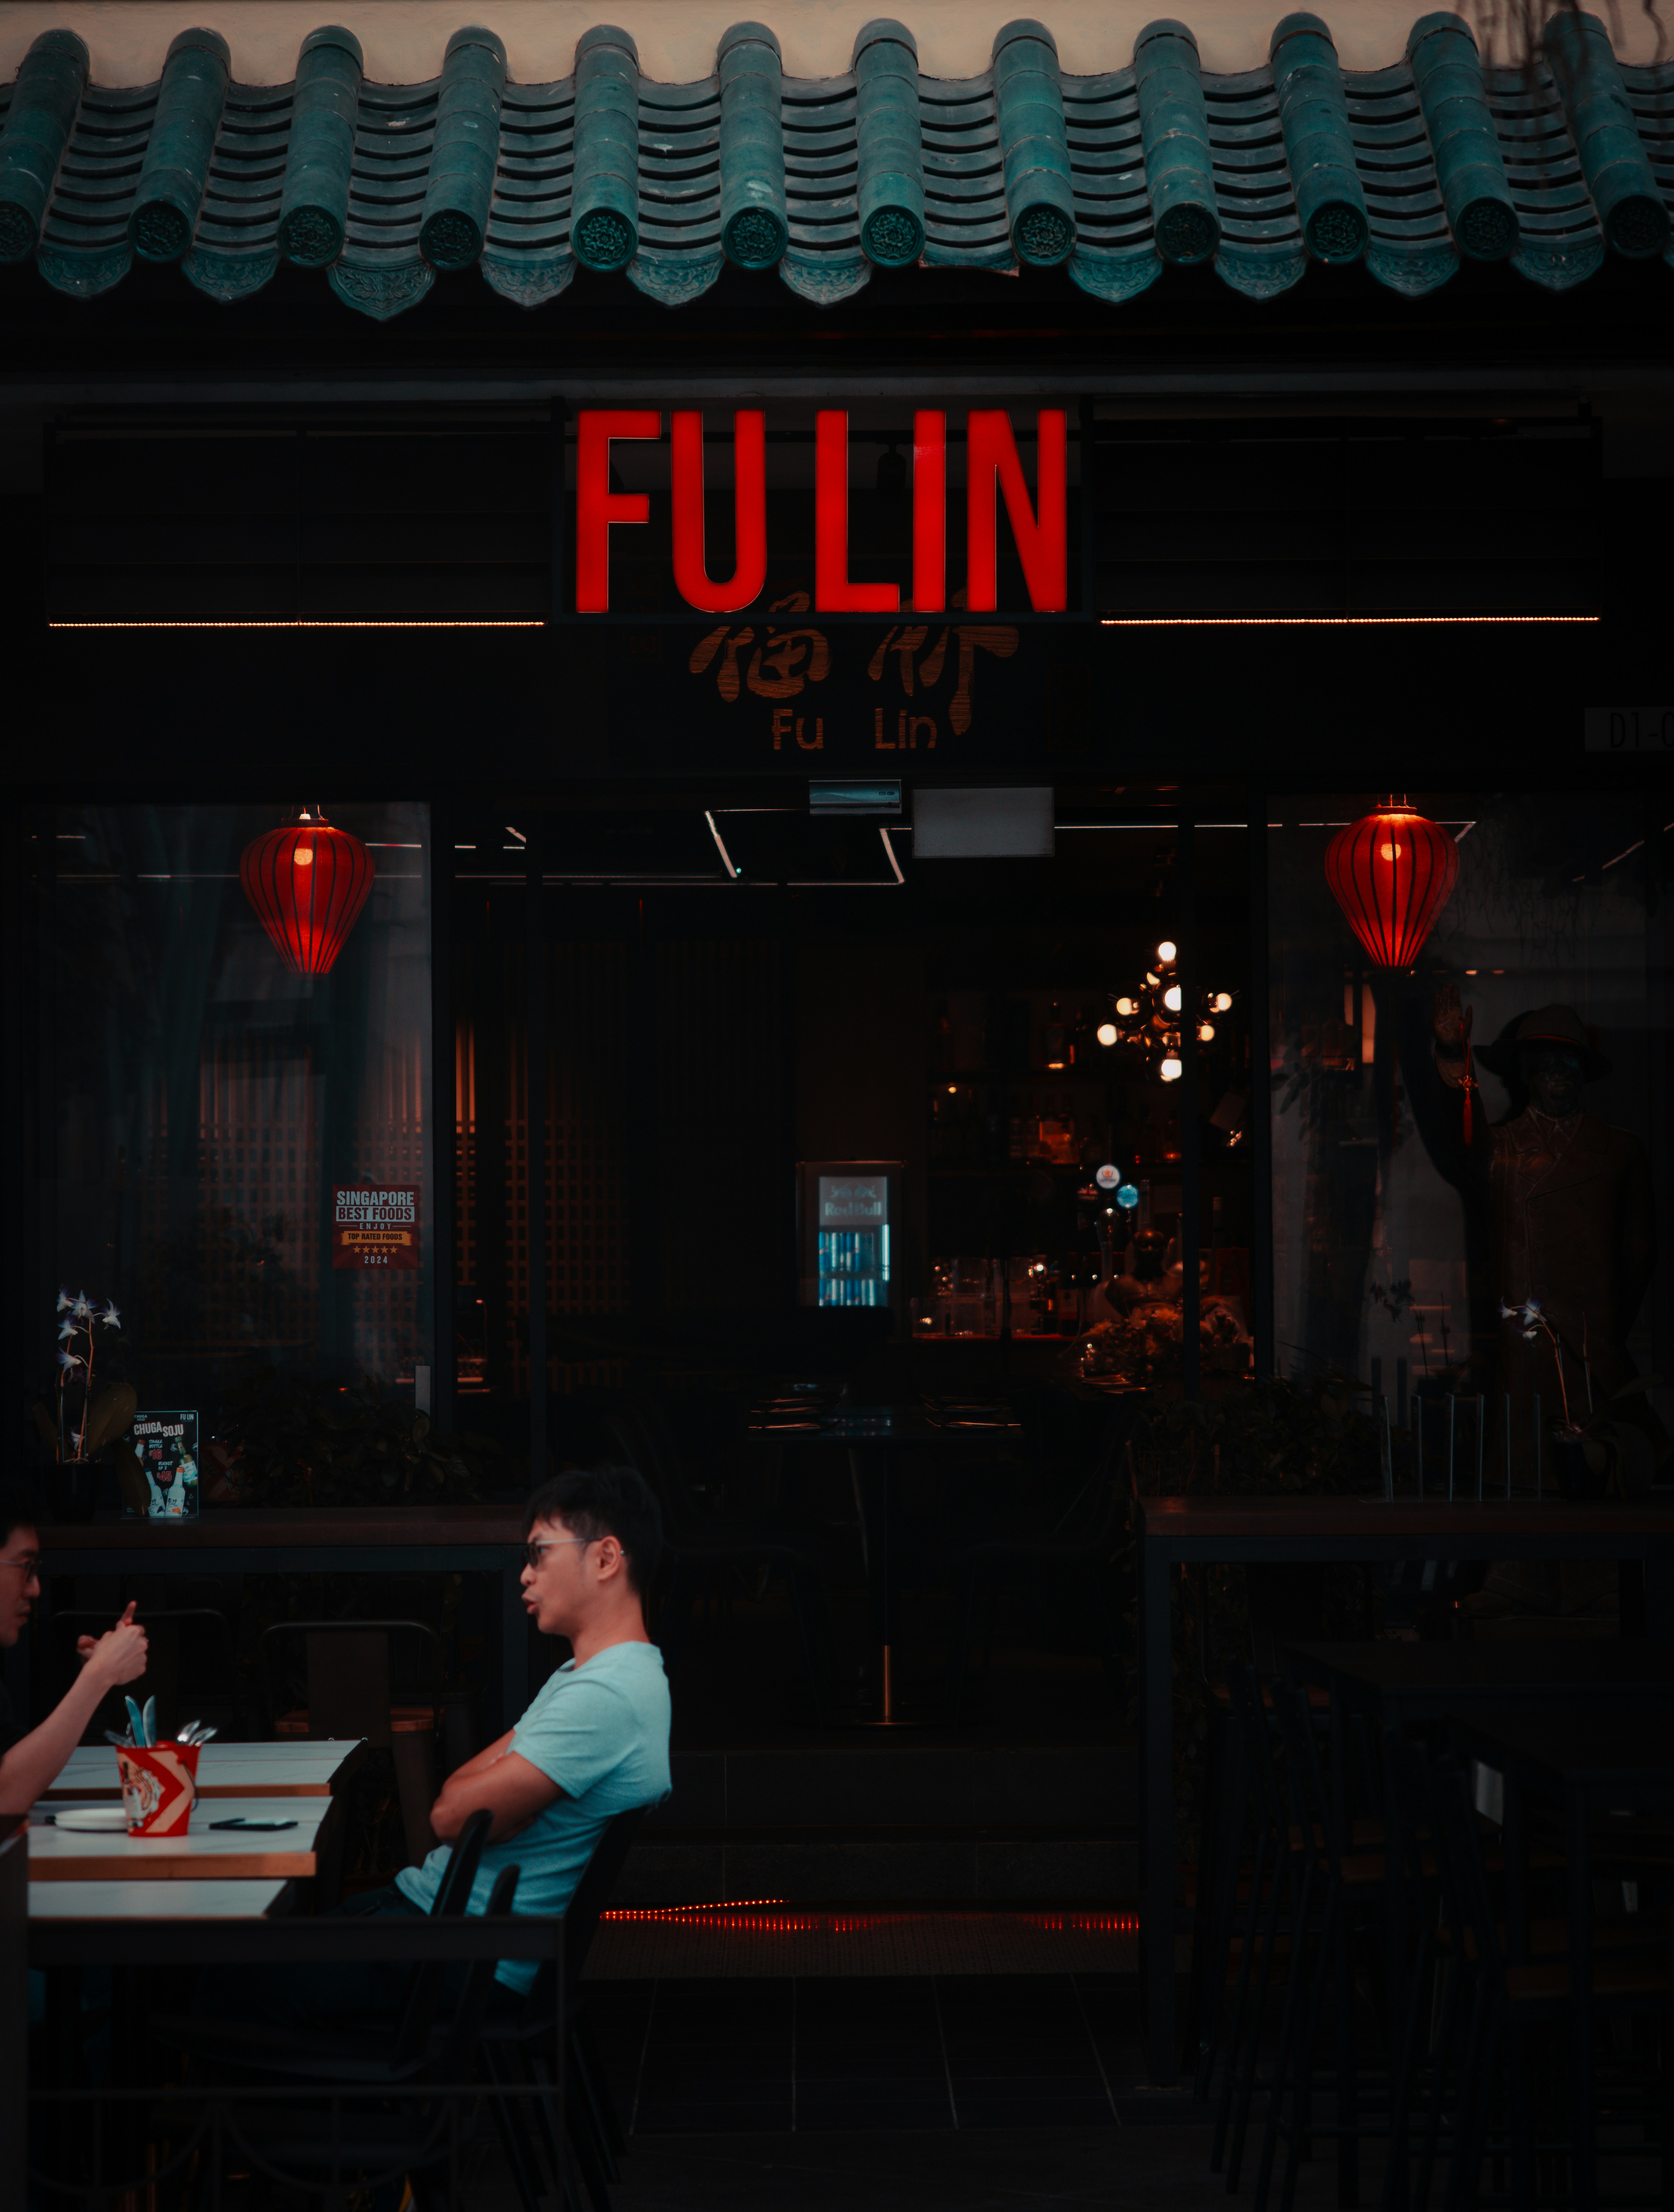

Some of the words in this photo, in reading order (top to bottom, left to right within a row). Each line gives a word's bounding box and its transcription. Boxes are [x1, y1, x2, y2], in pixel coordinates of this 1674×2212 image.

[576, 409, 767, 613] FU
[815, 408, 1068, 612] LIN
[772, 708, 824, 750] Fu
[875, 708, 937, 749] Lin
[337, 1191, 414, 1206] SINGAPORE
[338, 1207, 369, 1220] BEST
[372, 1207, 412, 1220] FOODS
[825, 1201, 853, 1216] Red
[854, 1201, 881, 1216] Bull
[133, 1421, 162, 1435] CHUGA
[162, 1424, 184, 1437] SOJU
[149, 1449, 162, 1460] $16
[157, 1471, 172, 1482] $45
